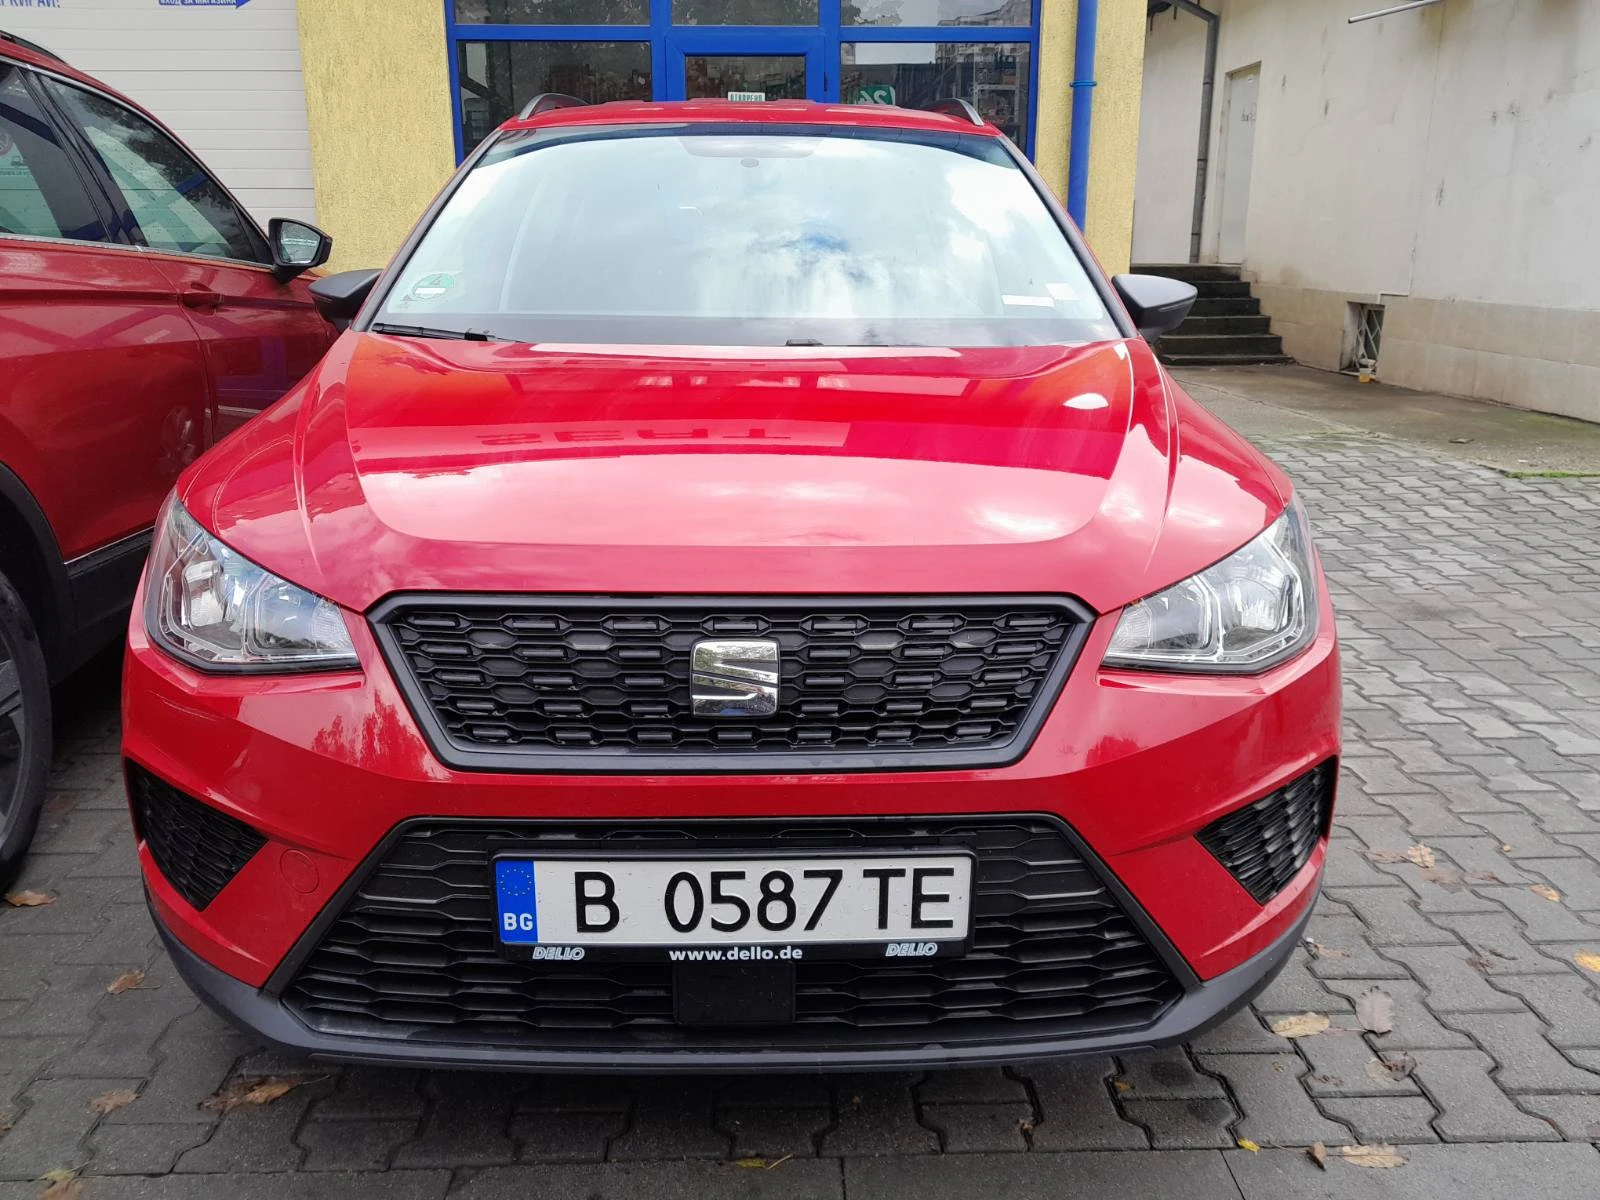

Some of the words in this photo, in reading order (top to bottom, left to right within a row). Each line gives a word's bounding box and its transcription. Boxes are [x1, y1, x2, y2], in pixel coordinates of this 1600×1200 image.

[575, 871, 620, 933] B
[664, 869, 843, 933] 0587
[863, 867, 954, 930] TE
[503, 912, 533, 931] BG
[532, 946, 585, 961] DELLO
[669, 946, 803, 961] www.dello.de
[885, 942, 938, 957] DELLO
